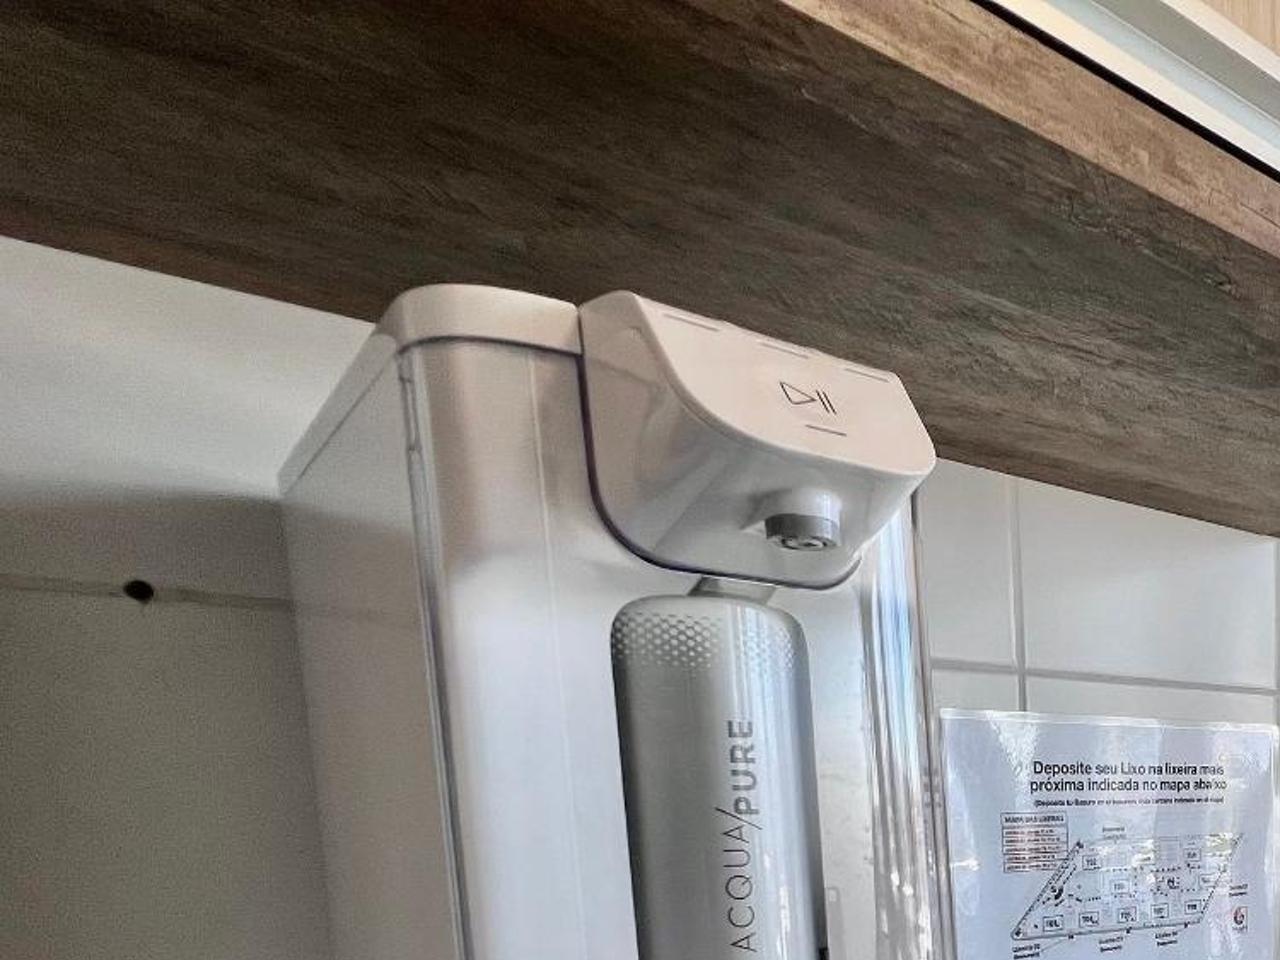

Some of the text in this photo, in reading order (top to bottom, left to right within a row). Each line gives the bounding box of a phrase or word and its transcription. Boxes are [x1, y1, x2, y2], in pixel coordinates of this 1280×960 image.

[1033, 760, 1225, 777] Deposite seu Lixo na lixeira mais
[1030, 776, 1085, 794] próxima
[1088, 777, 1140, 792] indicada
[1142, 780, 1158, 792] no
[1159, 780, 1191, 794] mapa
[715, 719, 763, 952] ACQUA/PURE
